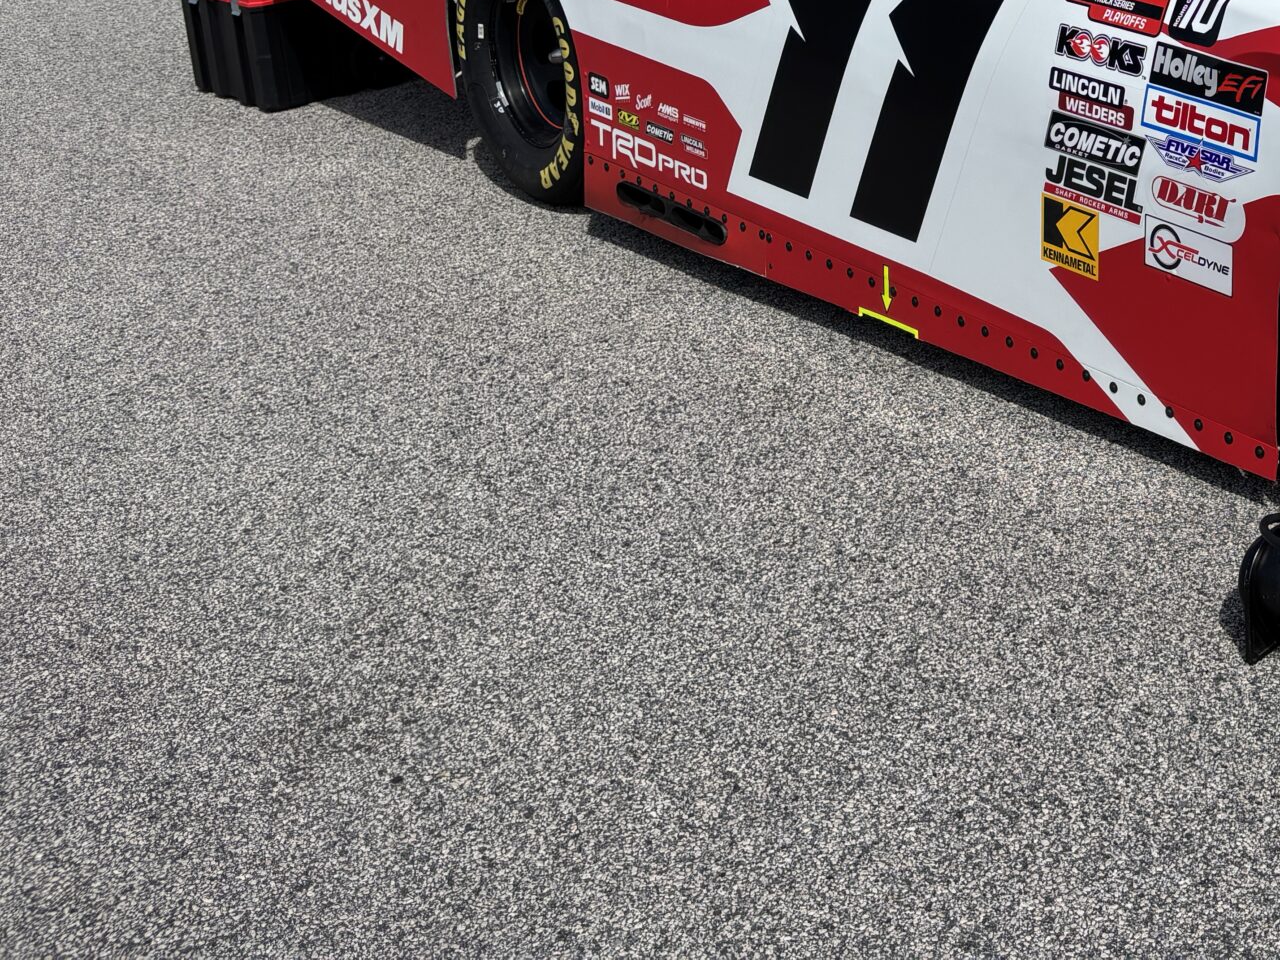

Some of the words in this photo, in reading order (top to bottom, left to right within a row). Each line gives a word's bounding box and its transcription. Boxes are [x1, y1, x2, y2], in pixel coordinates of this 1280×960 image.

[1102, 8, 1148, 30] PLAYOFFS
[1055, 24, 1148, 77] KOOKS
[590, 76, 607, 96] SEM
[1153, 45, 1218, 98] Holley
[614, 83, 630, 96] WIX
[1052, 74, 1121, 106] LINCOLN
[590, 99, 604, 114] Mobil
[657, 102, 679, 119] HMS
[1065, 95, 1126, 127] WELDERS
[646, 124, 673, 142] COMETIC
[1151, 95, 1251, 152] tilton
[590, 119, 656, 169] TRD
[658, 153, 708, 190] PRO
[1050, 122, 1141, 168] COMETIC
[1054, 143, 1090, 159] GASKET
[1165, 140, 1200, 157] FIVE
[1200, 149, 1232, 170] STAR
[1165, 152, 1189, 165] RaceCar
[1204, 164, 1225, 177] Bodies
[1045, 155, 1143, 214] JESEL
[1054, 187, 1077, 201] SHAFT
[1079, 194, 1106, 210] ROCKER
[1108, 205, 1129, 220] ARMS
[1156, 177, 1237, 224] DART
[1043, 246, 1097, 277] KENNAMETAL
